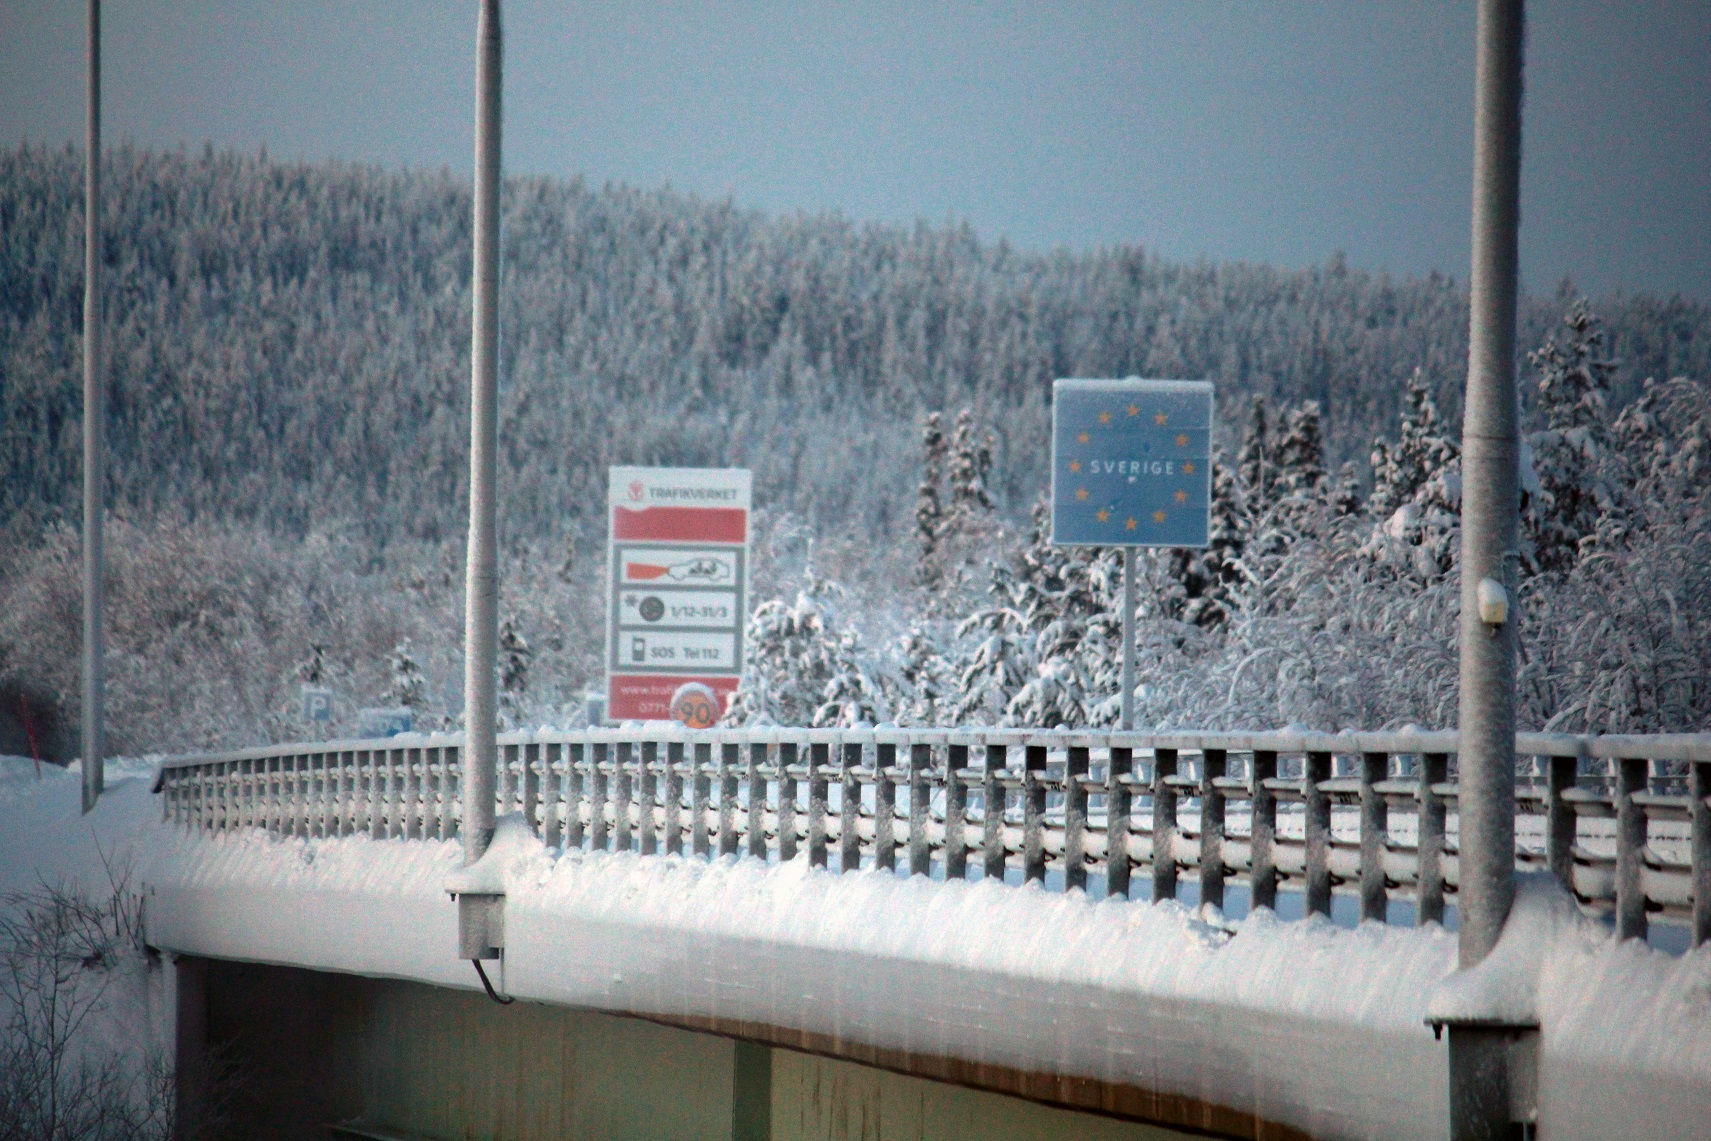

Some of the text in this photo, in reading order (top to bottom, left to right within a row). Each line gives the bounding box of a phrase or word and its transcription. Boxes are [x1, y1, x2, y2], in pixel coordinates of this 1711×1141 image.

[1090, 459, 1175, 475] SVERIGE
[649, 487, 738, 500] TRAFIKVERKET
[650, 646, 676, 659] SOS
[701, 648, 720, 660] 112
[310, 696, 327, 718] P
[680, 701, 711, 725] 90
